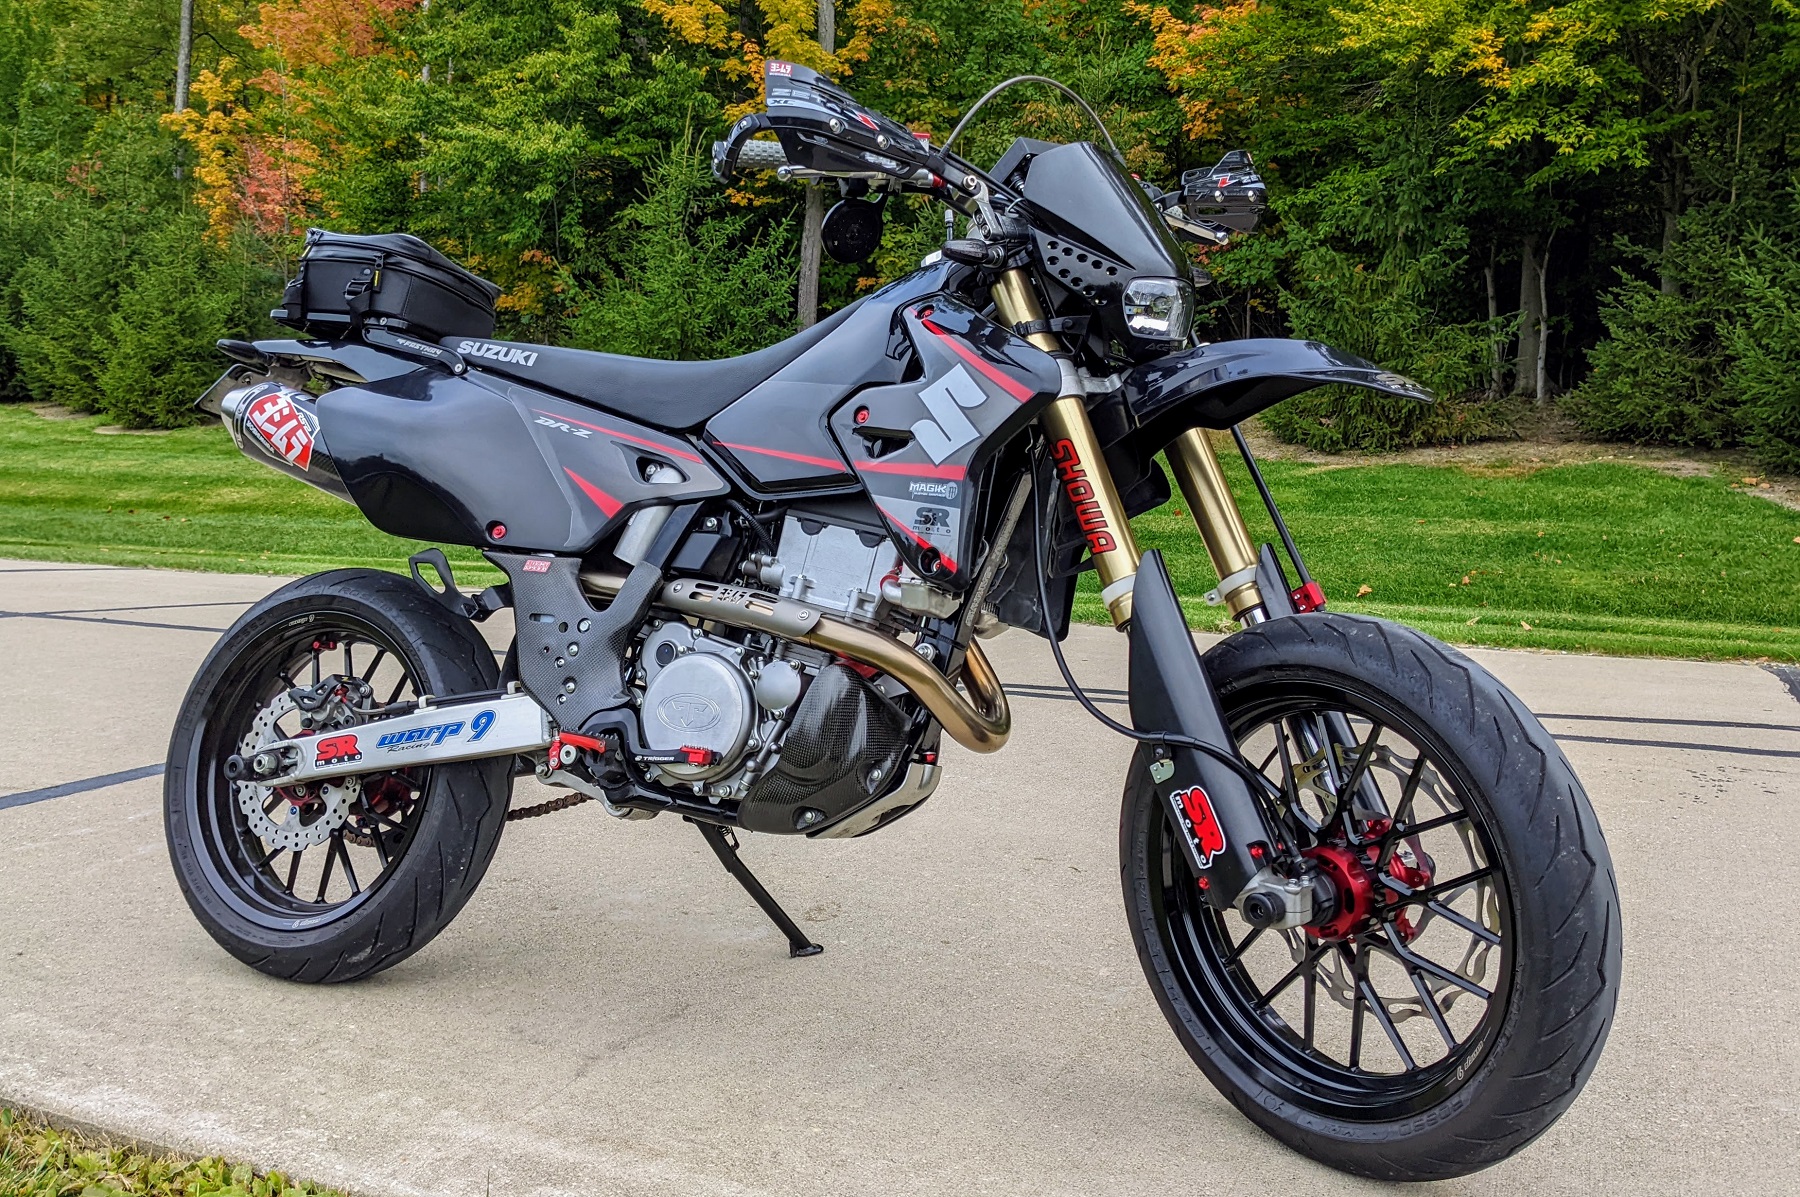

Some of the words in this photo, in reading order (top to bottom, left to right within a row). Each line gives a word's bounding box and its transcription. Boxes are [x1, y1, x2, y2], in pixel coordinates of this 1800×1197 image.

[457, 341, 539, 367] SUZUKI
[534, 416, 593, 439] DR-Z
[909, 482, 947, 493] MAGIK
[1049, 438, 1118, 555] SHOWA
[914, 506, 950, 528] SR
[376, 721, 466, 748] warp
[467, 709, 497, 742] 9
[317, 734, 360, 760] SR
[387, 742, 430, 754] Racing
[316, 754, 362, 767] moto
[1175, 796, 1206, 864] moto
[1181, 788, 1223, 859] SR
